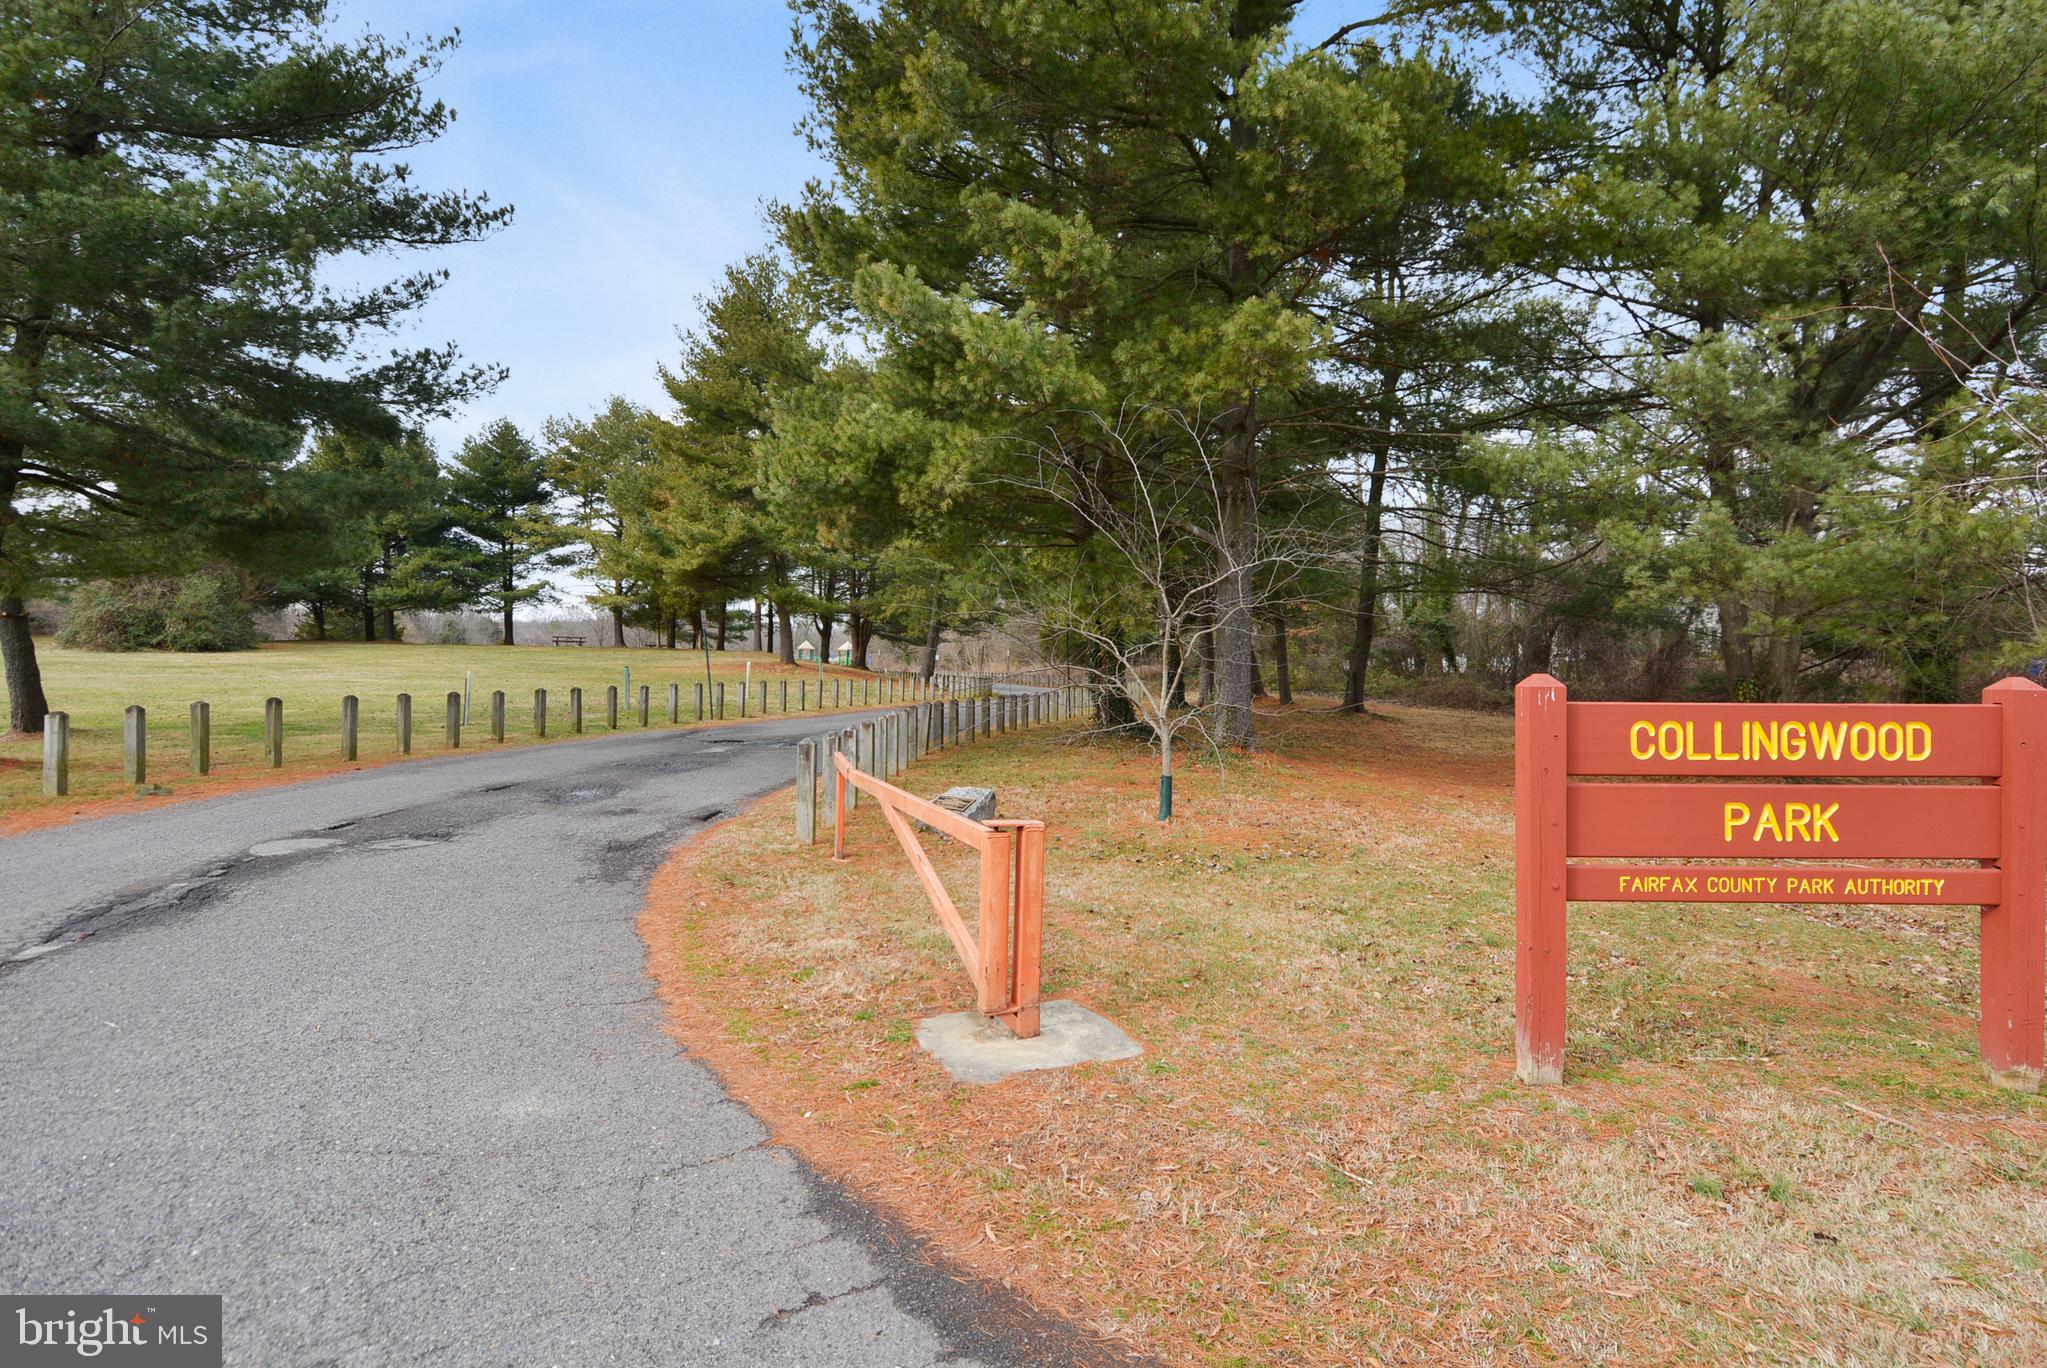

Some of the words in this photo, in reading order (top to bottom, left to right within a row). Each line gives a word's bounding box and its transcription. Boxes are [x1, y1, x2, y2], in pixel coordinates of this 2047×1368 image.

[1629, 720, 1932, 761] COLLINGWOOD
[1723, 801, 1840, 842] PARK
[1618, 875, 1698, 893] FAIRFAX
[1706, 876, 1778, 894] COUNTY
[1786, 877, 1835, 895] PARK
[1844, 878, 1946, 896] AUTHORITY
